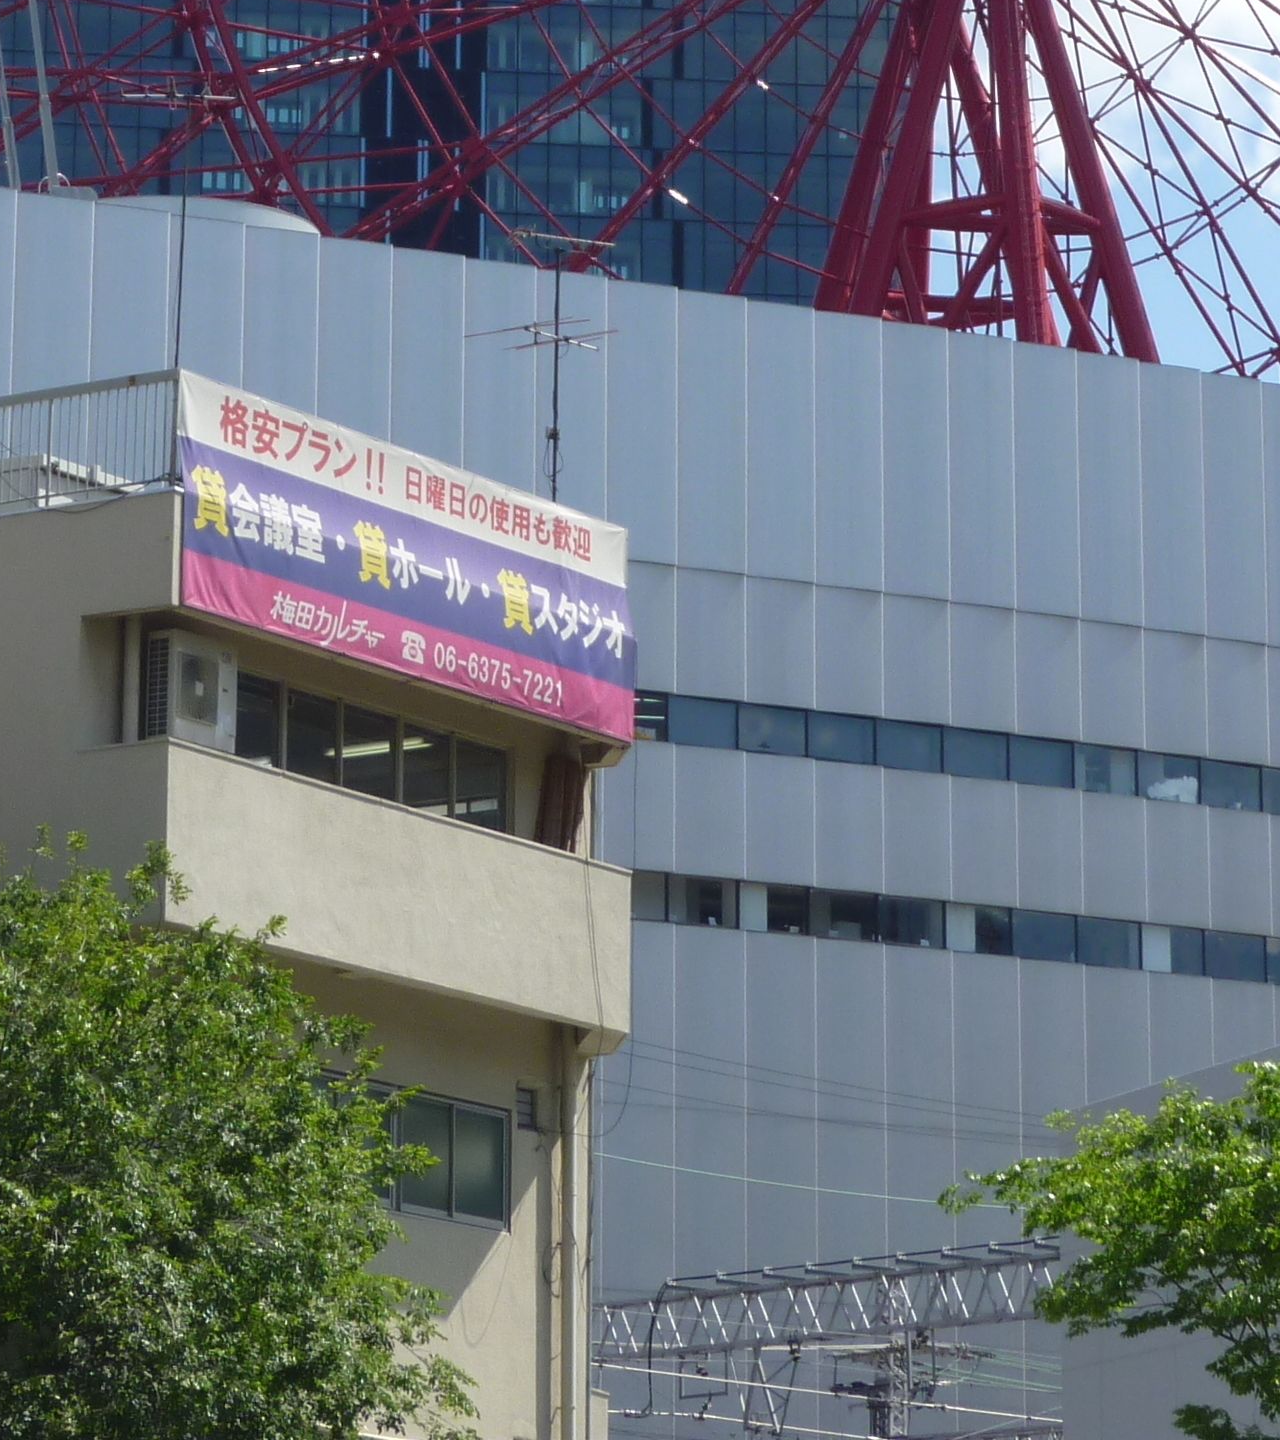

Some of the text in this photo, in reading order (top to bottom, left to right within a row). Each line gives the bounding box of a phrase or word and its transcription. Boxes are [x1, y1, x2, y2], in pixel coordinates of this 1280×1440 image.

[405, 464, 591, 562] 日曜日の使用も歓迎
[434, 642, 563, 707] 06-6375-7221
